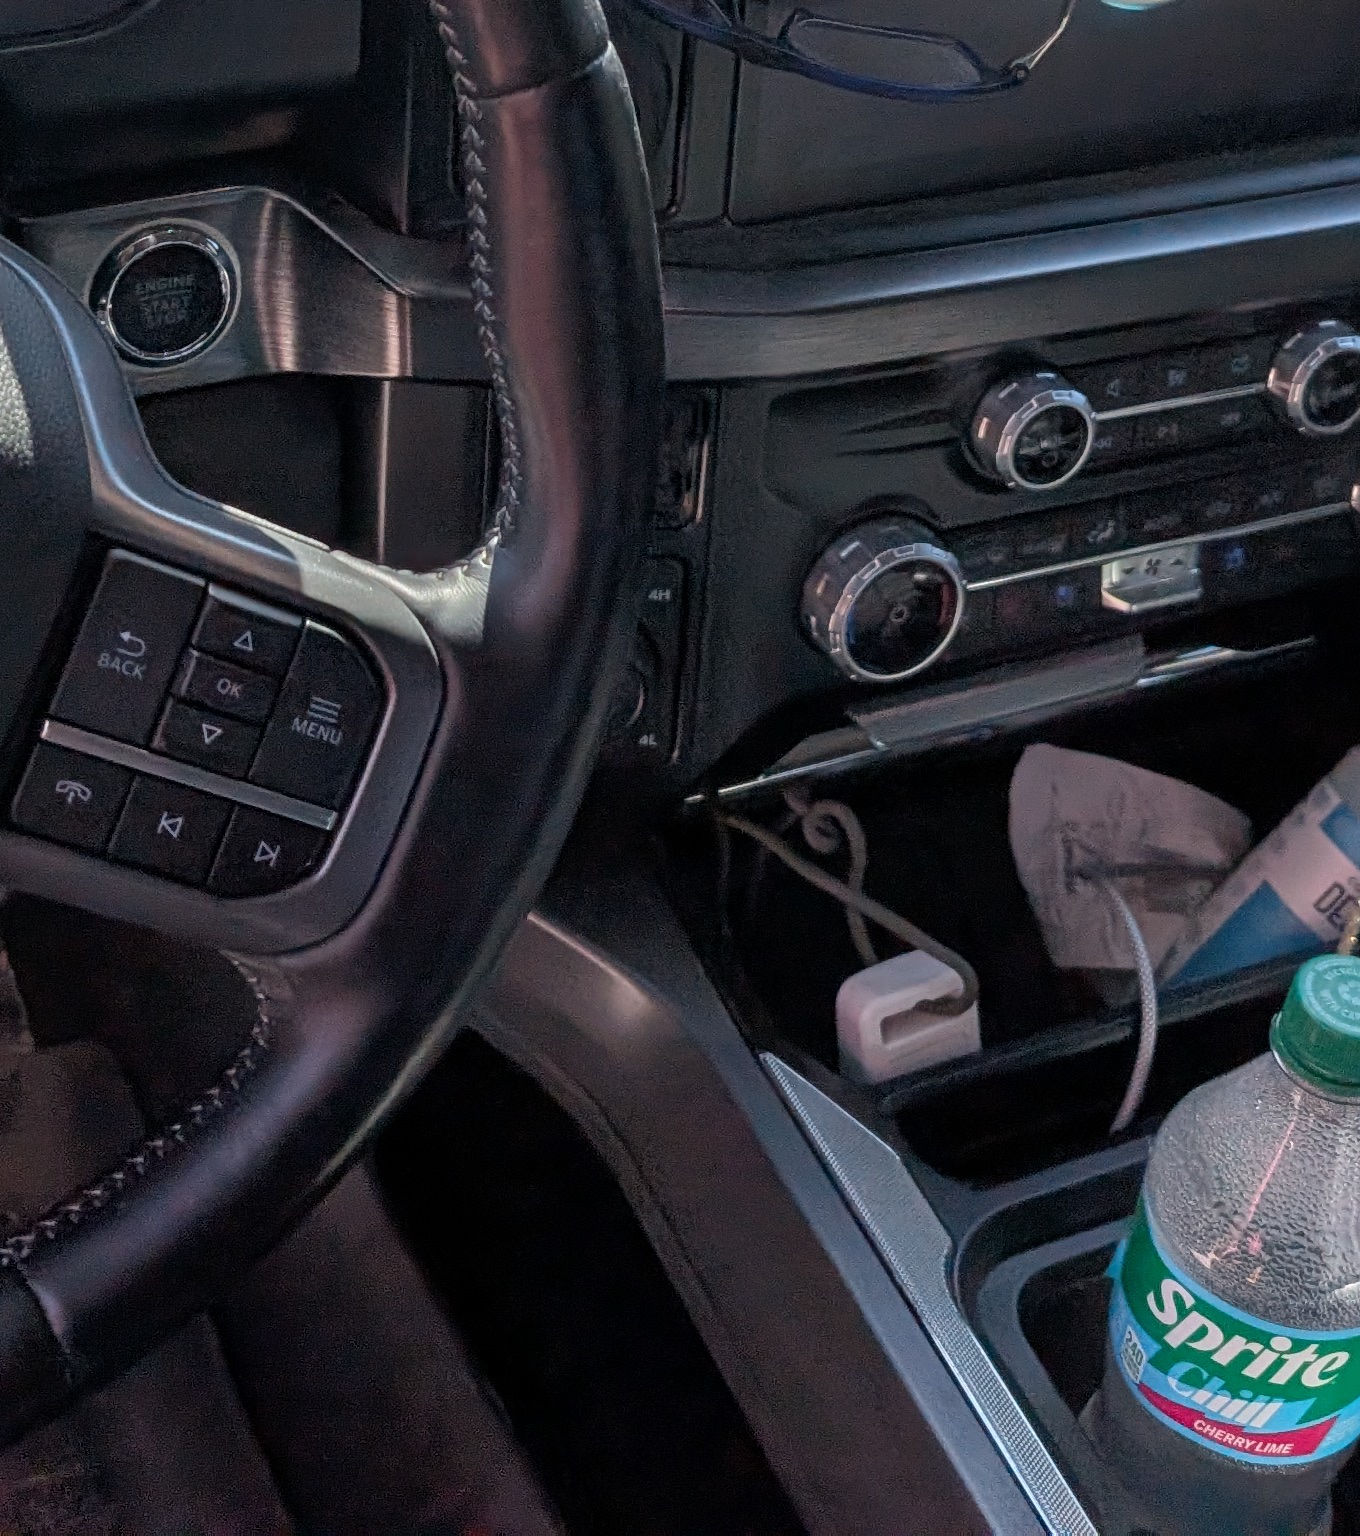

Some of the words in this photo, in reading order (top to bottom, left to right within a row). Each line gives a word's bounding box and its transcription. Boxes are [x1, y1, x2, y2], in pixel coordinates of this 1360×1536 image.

[647, 588, 672, 601] 4H
[97, 652, 146, 680] BACK
[216, 677, 243, 699] OK
[291, 716, 342, 746] MENU
[639, 734, 659, 748] 4L
[1146, 1278, 1350, 1388] Sprite
[1167, 1361, 1287, 1428] Chill
[1193, 1418, 1255, 1453] CHERRY
[1254, 1440, 1295, 1455] LIME
